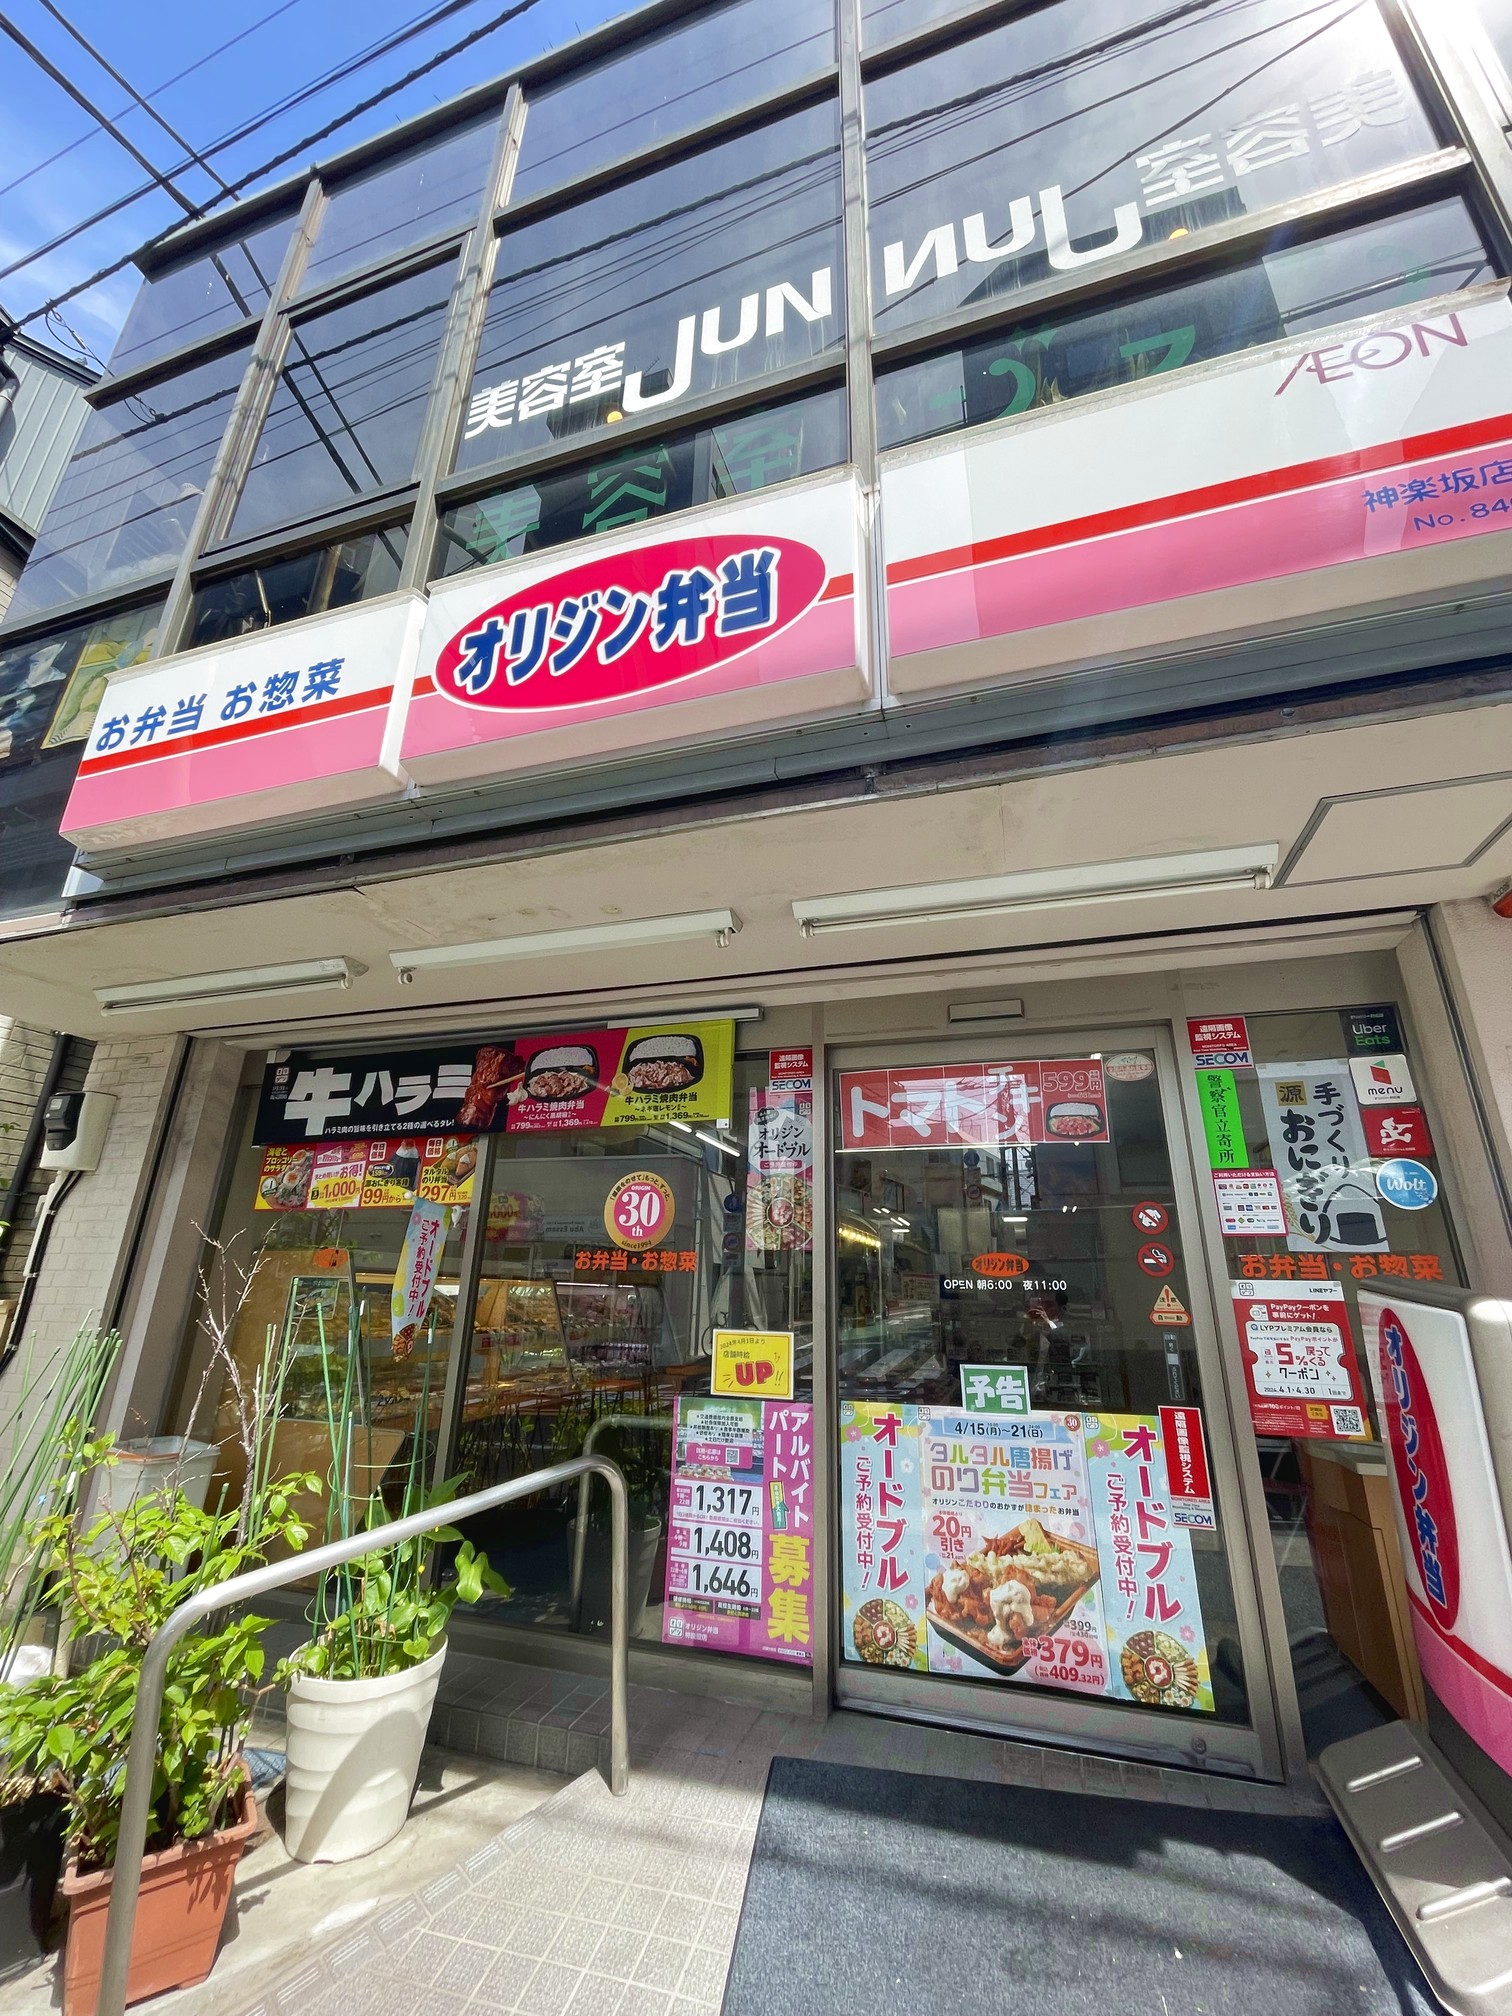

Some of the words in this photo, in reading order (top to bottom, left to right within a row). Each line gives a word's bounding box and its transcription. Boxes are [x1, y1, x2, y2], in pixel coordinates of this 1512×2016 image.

[464, 340, 625, 439] 美容室
[621, 267, 832, 412] JUN
[1361, 459, 1512, 512] 神楽坂店
[1413, 498, 1512, 531] No.84
[454, 546, 782, 696] オリジン弁当
[96, 693, 208, 752] お弁当
[220, 657, 346, 721] お惣菜
[1352, 1024, 1387, 1035] Uber
[1354, 1036, 1391, 1046] Eats
[1195, 1052, 1249, 1066] SECOM
[624, 1092, 698, 1105] 牛ハラミ焼肉弁当
[772, 1079, 811, 1090] SECOM
[1279, 1085, 1304, 1103] 源
[1367, 1086, 1403, 1096] menu
[283, 1063, 474, 1137] 牛ハラミ
[517, 1099, 585, 1114] 牛ハラミ焼肉弁当
[758, 1125, 805, 1140] オリジン
[1206, 1074, 1235, 1164] 警察官立寄所
[1312, 1081, 1351, 1180] 手づくり
[753, 1141, 811, 1159] オードブル
[1279, 1108, 1332, 1245] おにぎり
[1386, 1177, 1427, 1191] Wolt
[618, 1191, 661, 1227] 30
[631, 1225, 643, 1237] th
[407, 1218, 430, 1318] ご予約受付中!
[415, 1219, 441, 1319] オードブル
[574, 1250, 698, 1272] お弁当・お惣菜
[974, 1256, 1025, 1273] オリジン弁当
[1240, 1253, 1444, 1281] お弁当・お惣菜
[943, 1279, 974, 1289] OPEN
[976, 1279, 1013, 1290] 朝6:00
[1022, 1280, 1067, 1291] 夜11:00
[1270, 1303, 1330, 1312] PayPayクーポンを
[1271, 1311, 1316, 1320] 事前にゲット!
[1259, 1324, 1333, 1333] LYPプレミアム会員なら
[1275, 1343, 1308, 1367] 5%
[1308, 1357, 1327, 1367] くる
[735, 1360, 774, 1387] UP
[1279, 1367, 1320, 1380] クーポン
[966, 1374, 1025, 1411] 予告
[769, 1410, 788, 1479] パート
[930, 1442, 1073, 1471] タルタル唐揚げ
[1173, 1411, 1196, 1495] 遠隔画像監視システム
[790, 1411, 811, 1528] アルバイト
[1383, 1324, 1448, 1610] オリジン弁当
[931, 1465, 1078, 1501] のり弁当フェア
[695, 1484, 760, 1516] 1,317円
[872, 1413, 910, 1593] オードブル
[855, 1456, 874, 1590] ご予約受付中!
[932, 1515, 972, 1539] 20円
[1122, 1424, 1184, 1623] オードブル
[1174, 1512, 1212, 1526] SECOM
[694, 1527, 759, 1559] 1,408円
[940, 1537, 965, 1553] 引き
[1107, 1473, 1138, 1620] ご予約受付中!
[692, 1563, 759, 1598] 1,646円
[767, 1533, 810, 1645] 募集
[1038, 1636, 1104, 1669] 379円
